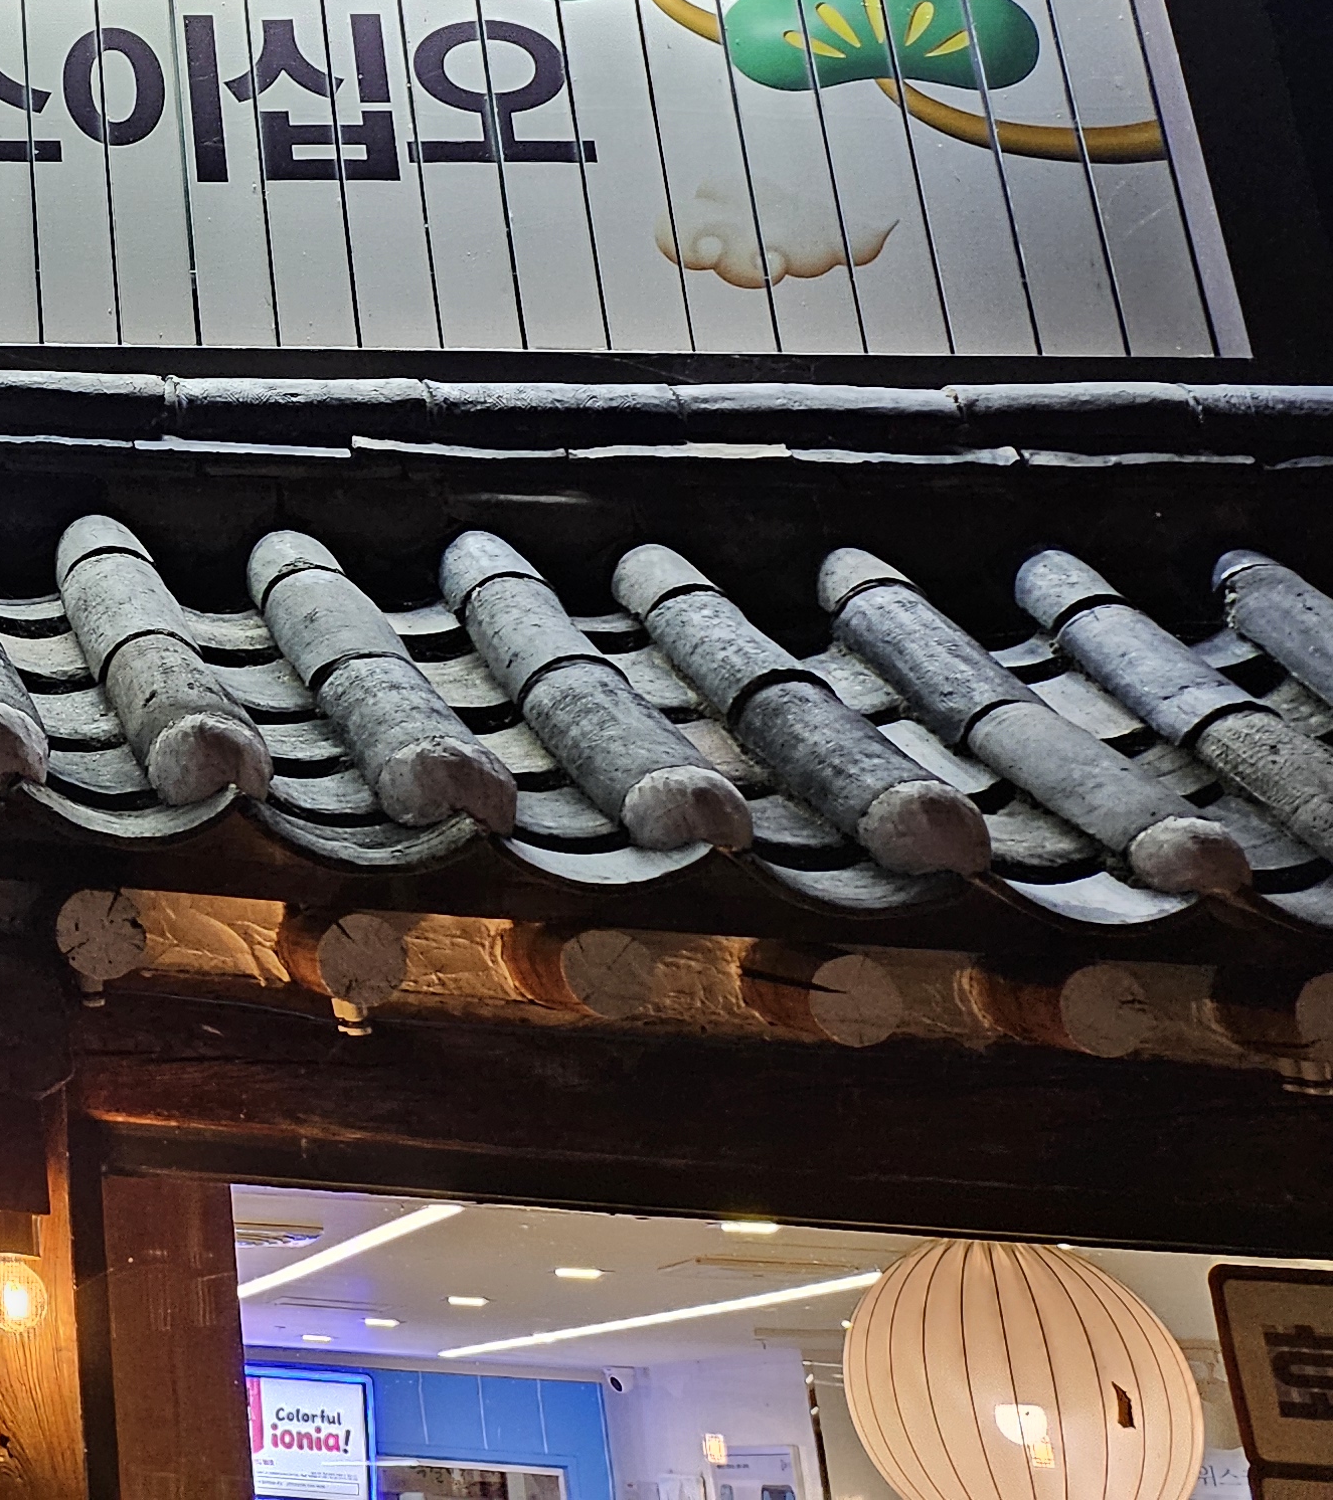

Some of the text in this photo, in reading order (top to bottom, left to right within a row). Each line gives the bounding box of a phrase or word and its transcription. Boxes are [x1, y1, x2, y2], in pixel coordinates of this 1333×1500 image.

[275, 1406, 342, 1426] Colorful
[270, 1422, 351, 1455] ionia!
[1198, 1464, 1250, 1487] 위스
